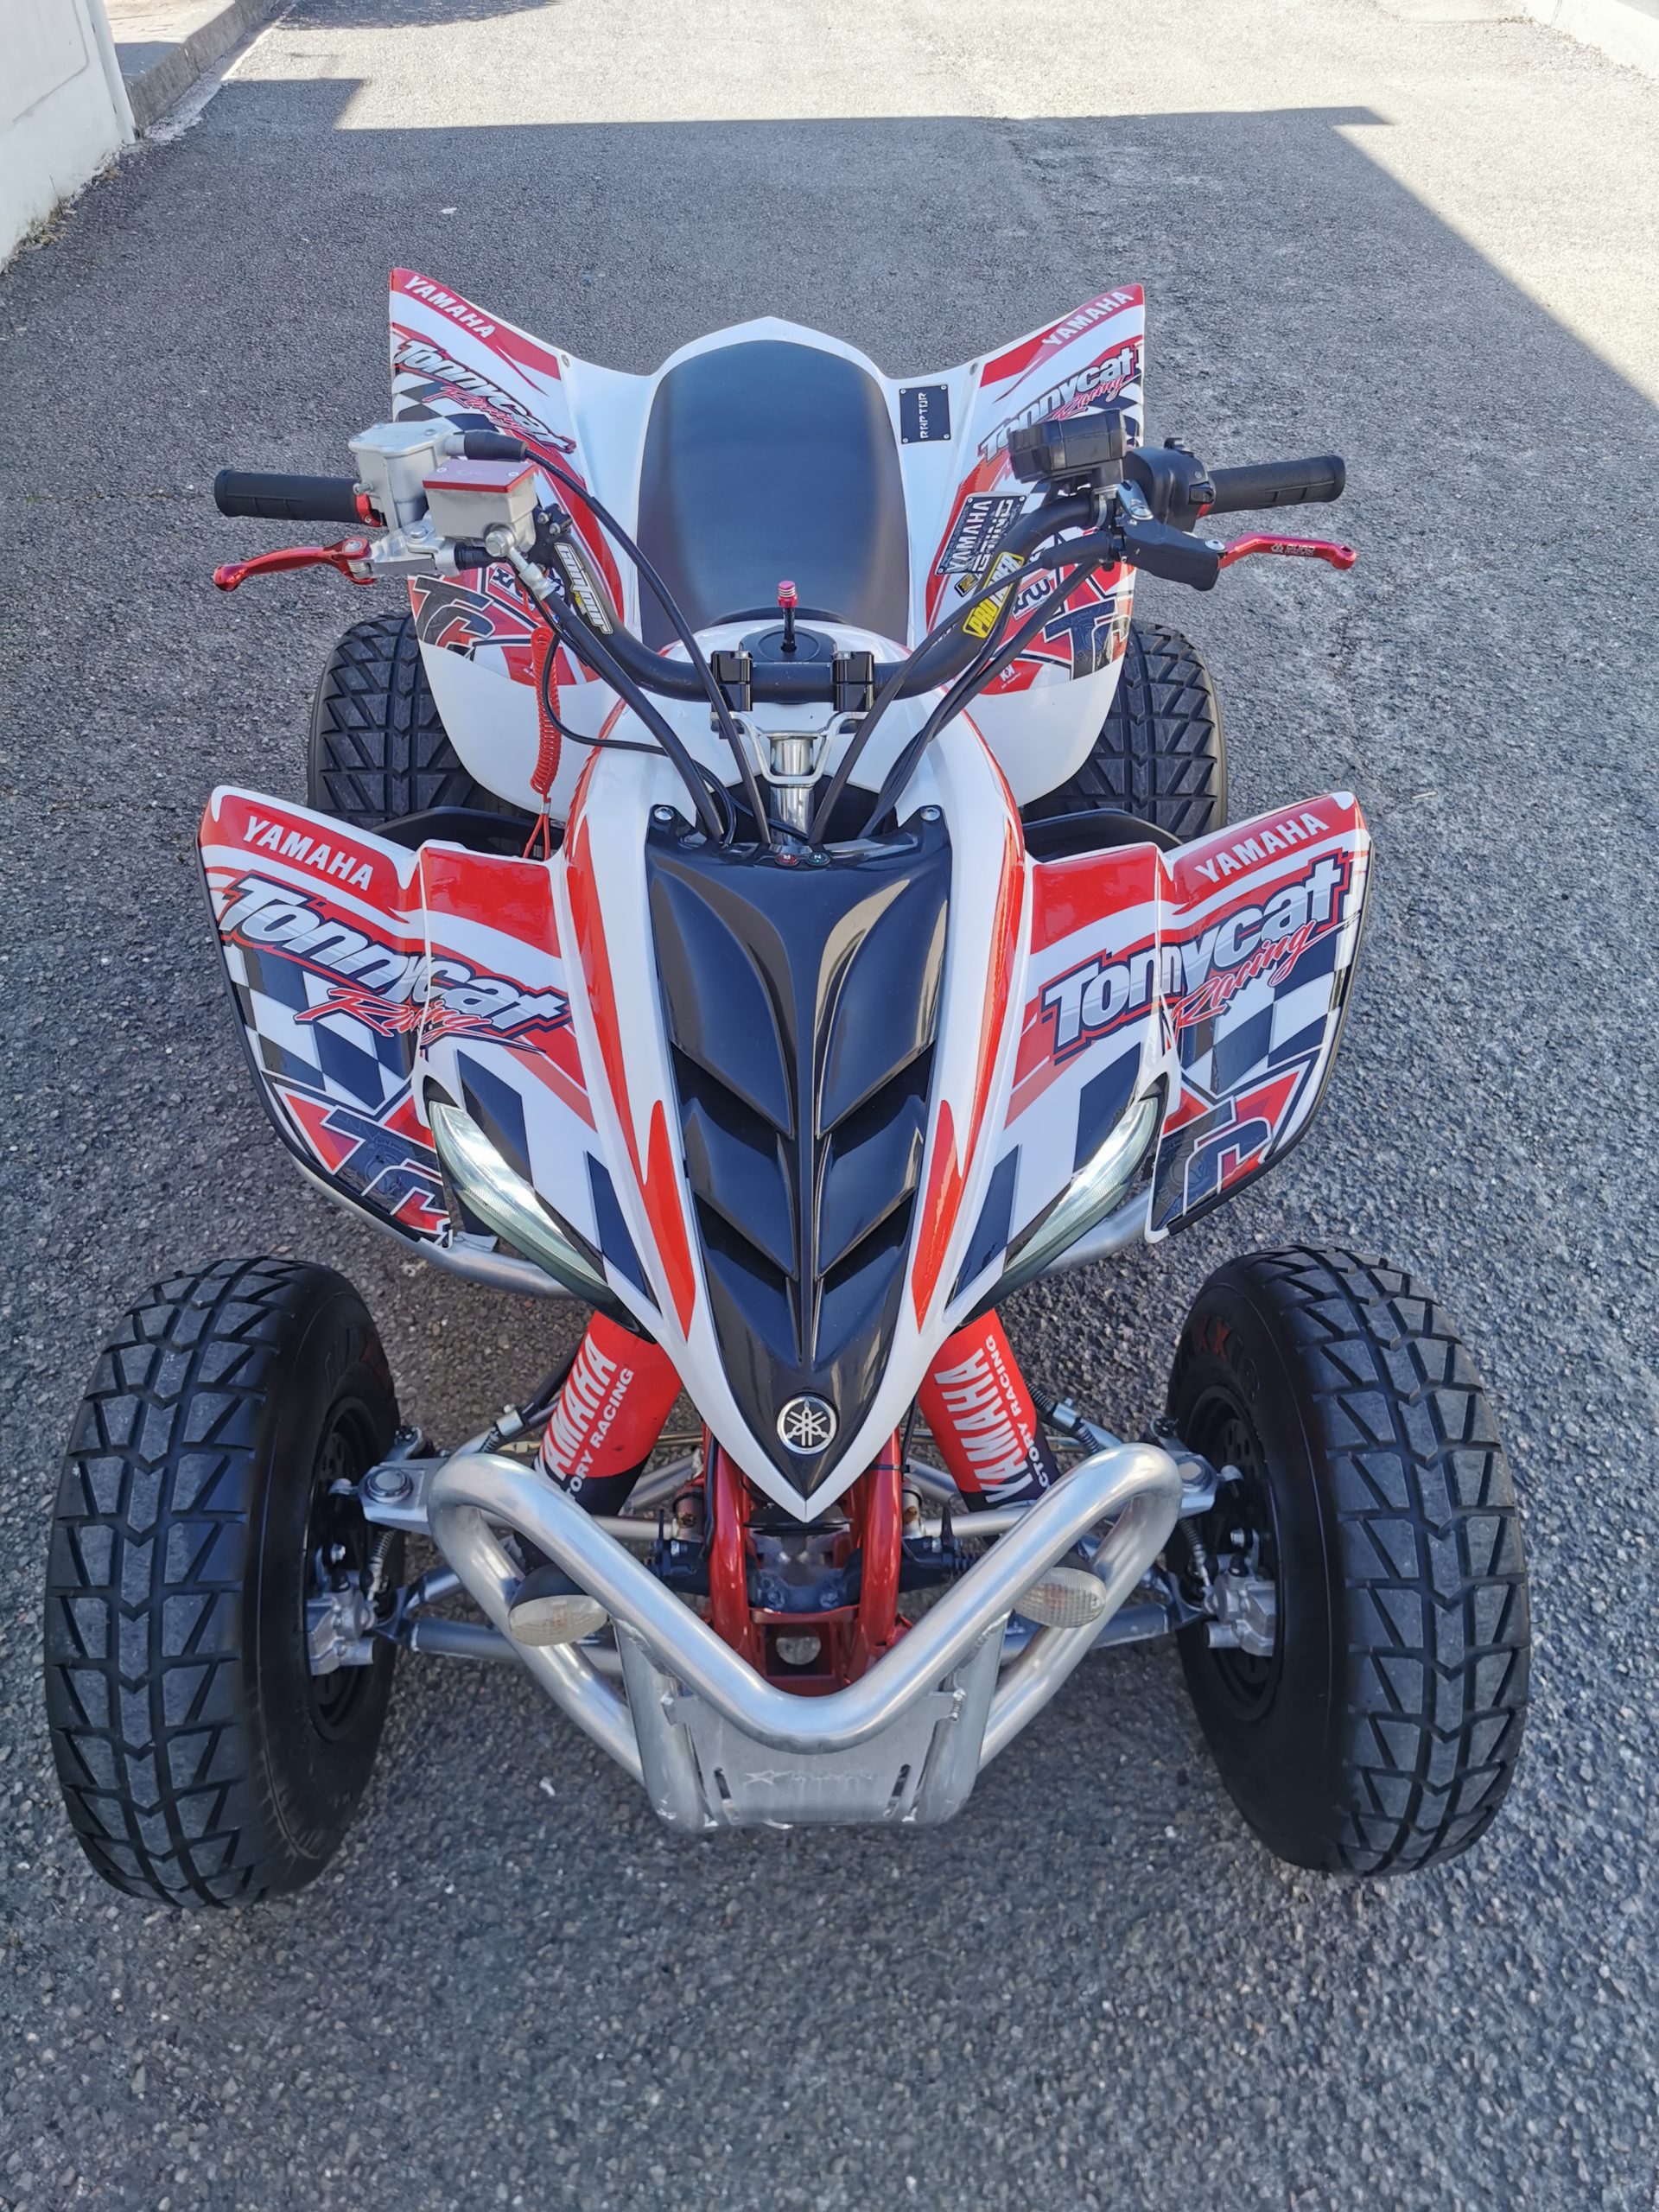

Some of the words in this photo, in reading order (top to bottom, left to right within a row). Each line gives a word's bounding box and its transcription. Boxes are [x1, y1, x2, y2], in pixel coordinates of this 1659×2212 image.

[404, 275, 497, 340] YAMAHA
[1041, 290, 1135, 346] YAMAHA
[946, 499, 993, 571] YAMAHA
[242, 815, 374, 892] YAMAHA
[1194, 811, 1330, 884] YAMAHA
[589, 1367, 634, 1448] RACING
[985, 1334, 1022, 1417] RACING
[933, 1347, 1034, 1504] YAMAHA
[1016, 1421, 1051, 1489] CTORY
